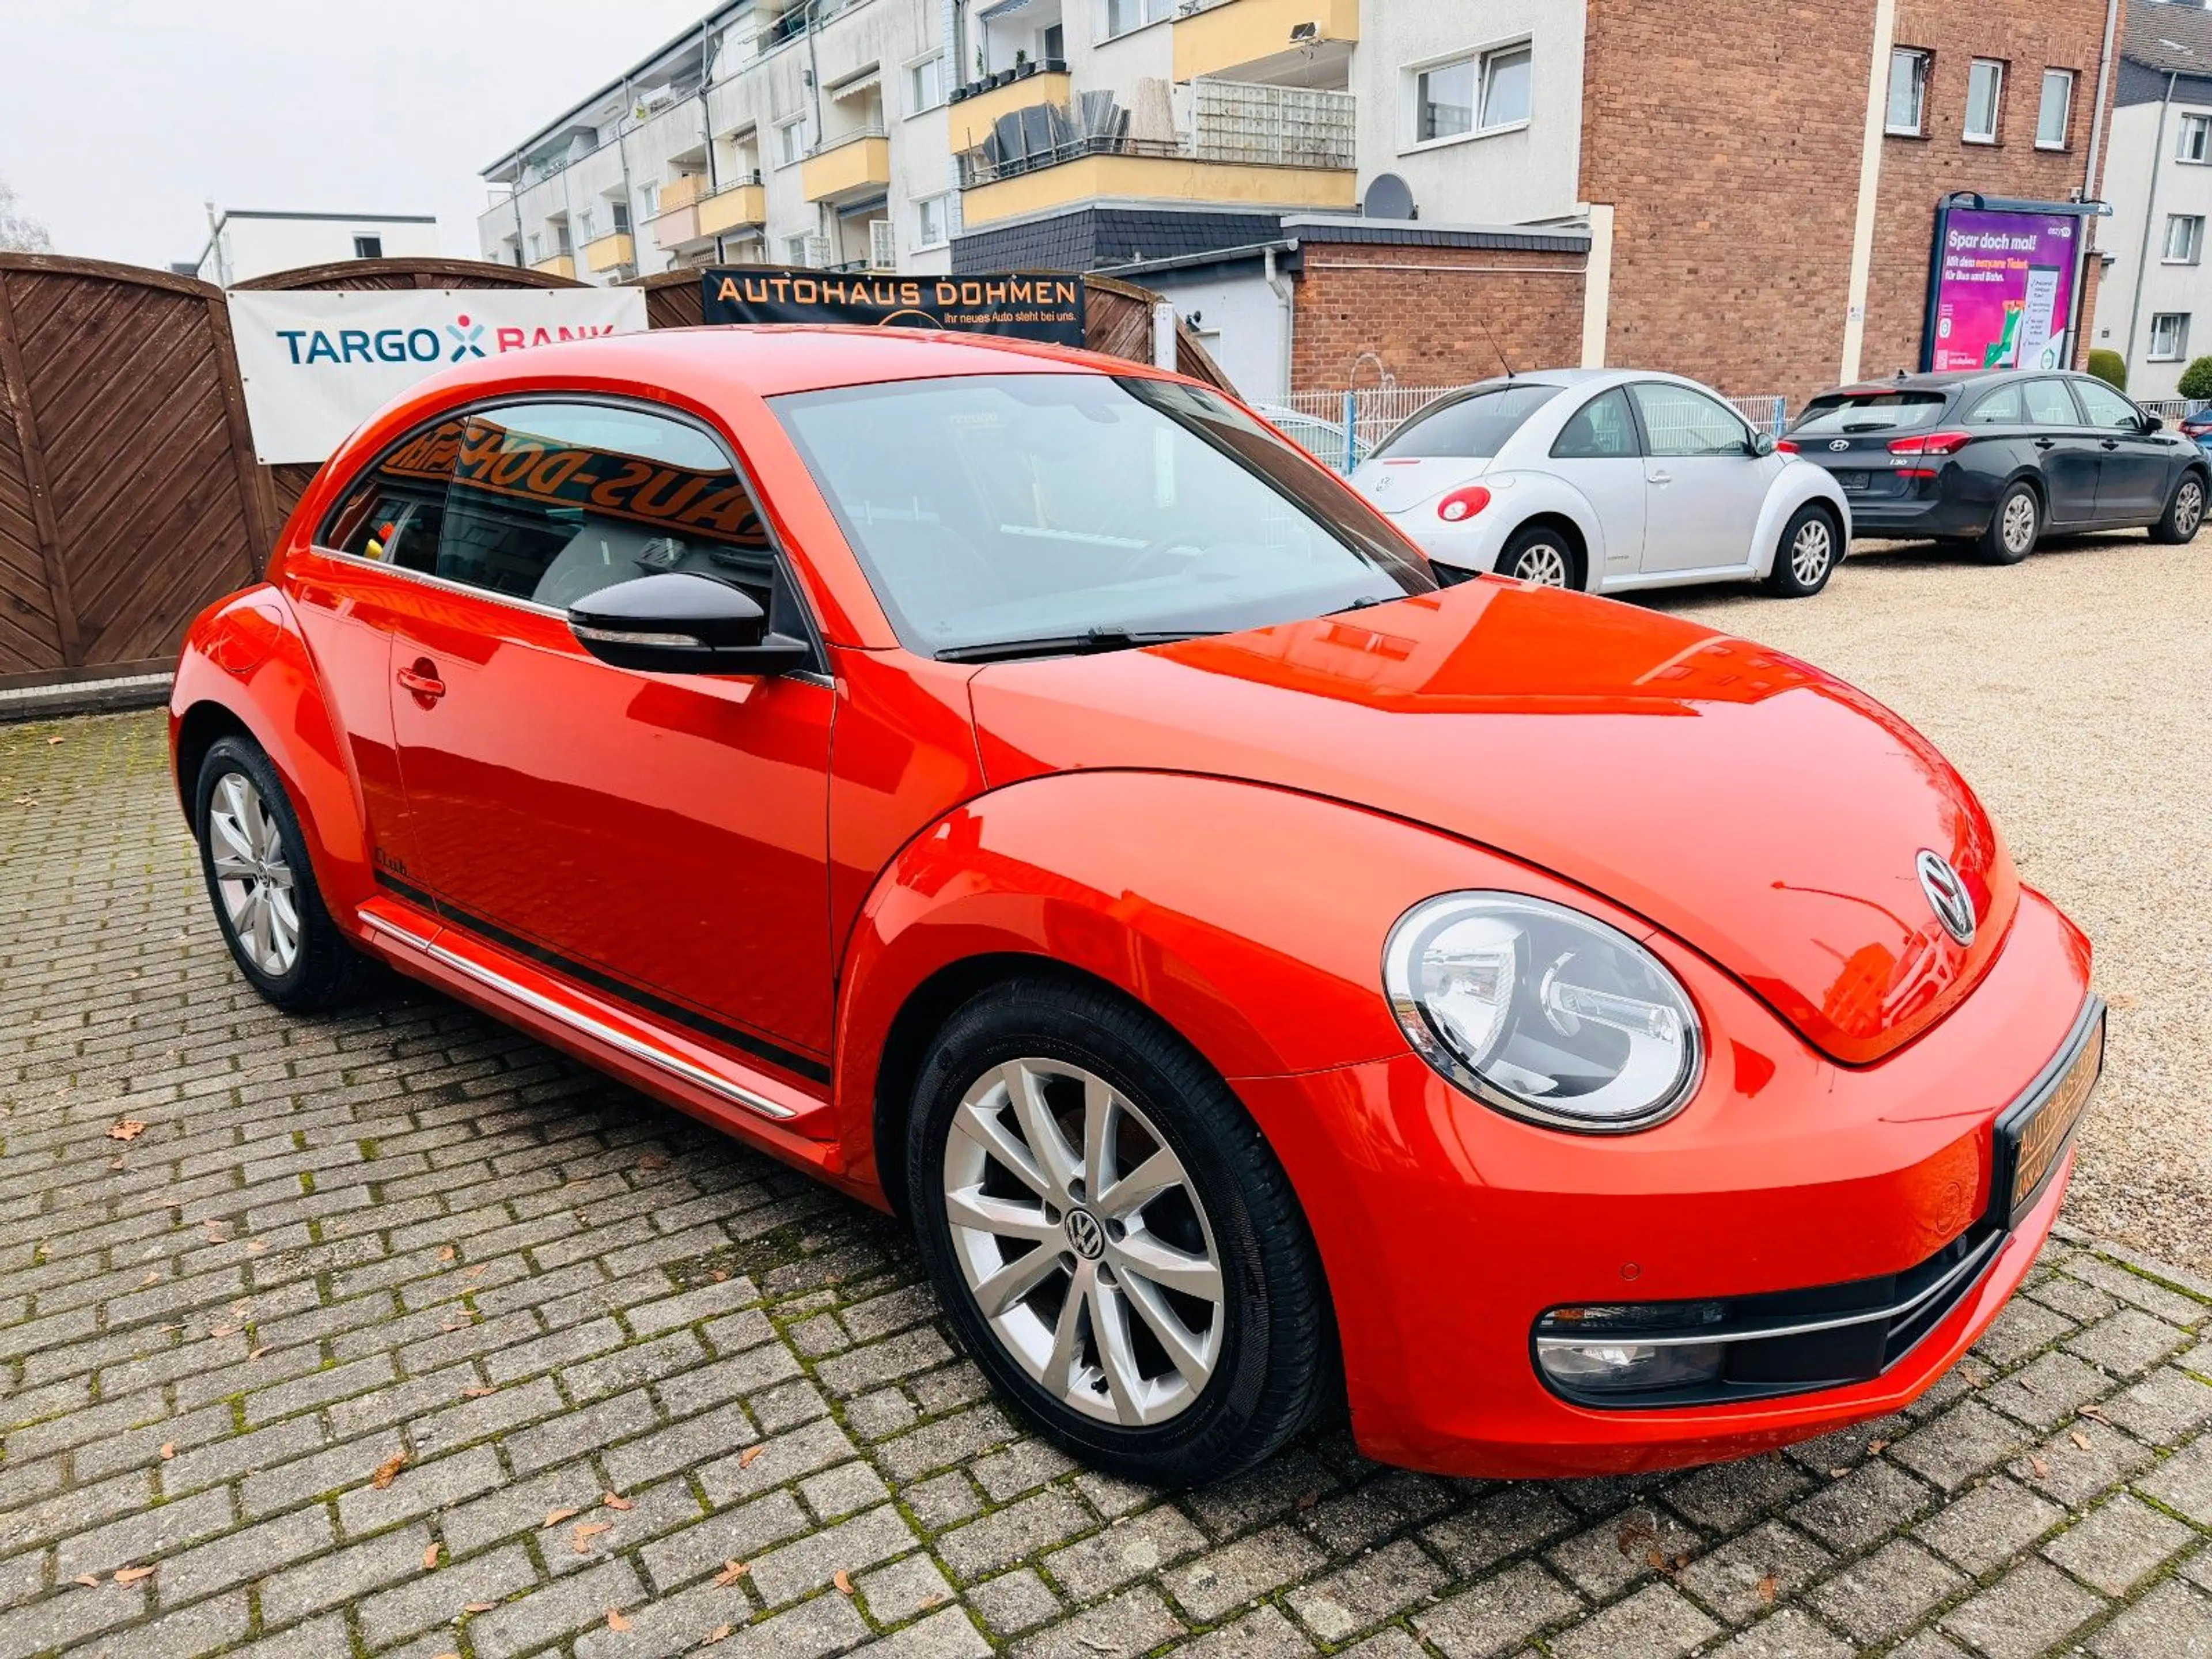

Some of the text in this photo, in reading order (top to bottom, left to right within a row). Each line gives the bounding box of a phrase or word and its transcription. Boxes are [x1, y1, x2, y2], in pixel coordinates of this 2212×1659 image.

[1949, 230, 2037, 251] Spar doch mal!
[717, 277, 1076, 306] AUTOHAUS DOHMEN
[945, 310, 1077, 324] Ihr neues Auto steht bei uns.
[276, 329, 440, 364] TARGO
